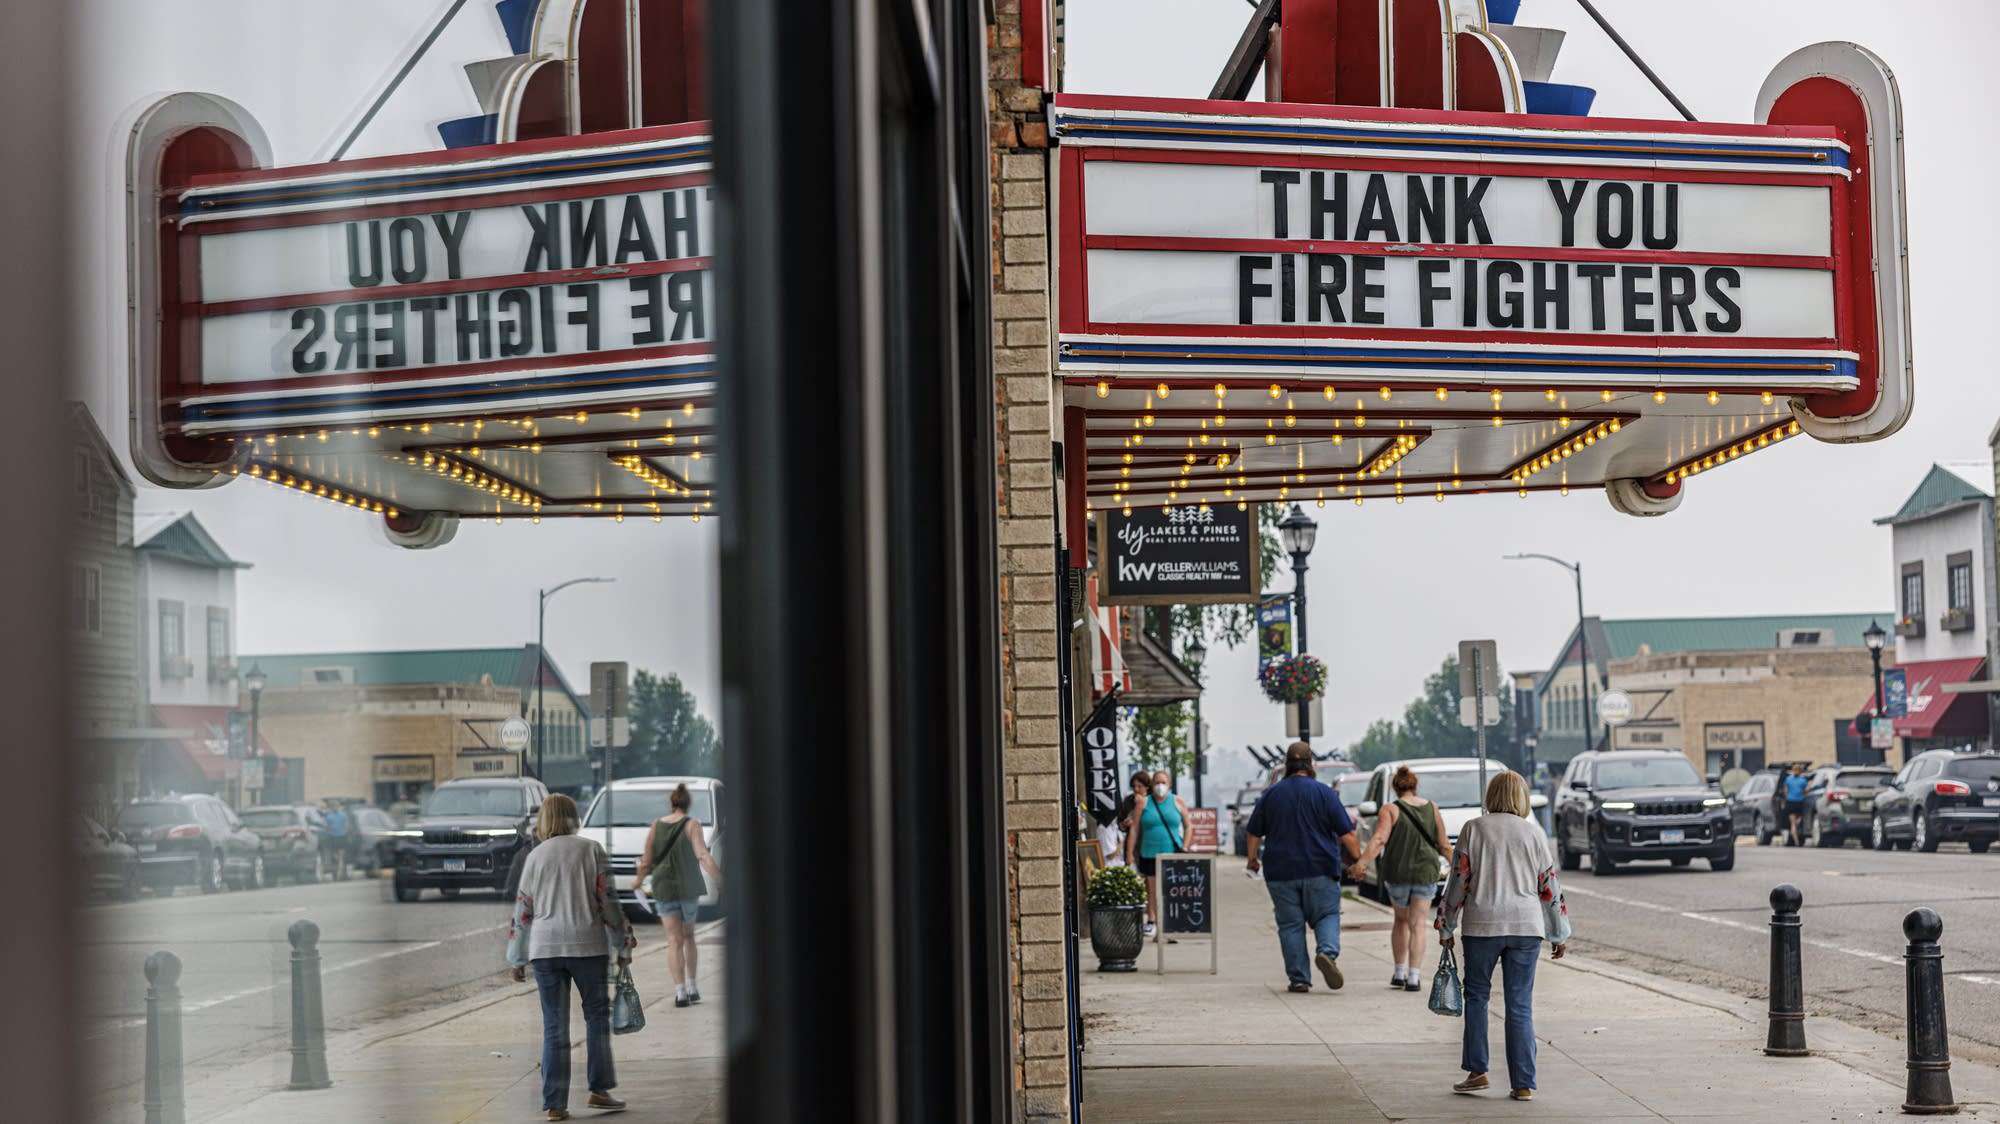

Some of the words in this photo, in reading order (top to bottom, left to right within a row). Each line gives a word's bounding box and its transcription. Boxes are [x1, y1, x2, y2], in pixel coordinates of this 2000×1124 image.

[1260, 170, 1494, 245] THANK
[1547, 179, 1679, 250] YOU
[1239, 255, 1386, 325] FIRE
[1418, 259, 1742, 333] FIGHTERS
[1117, 522, 1149, 555] ely
[1150, 526, 1186, 536] LAKES
[1191, 526, 1199, 535] &
[1204, 525, 1237, 535] PINES
[1200, 535, 1240, 543] PARTNERS
[1118, 555, 1156, 581] kw
[1157, 572, 1185, 581] CLASSIC
[1186, 572, 1210, 581] REALTY
[1709, 731, 1758, 743] INSULA
[1086, 726, 1117, 812] OPEN
[1169, 886, 1205, 897] OPEN
